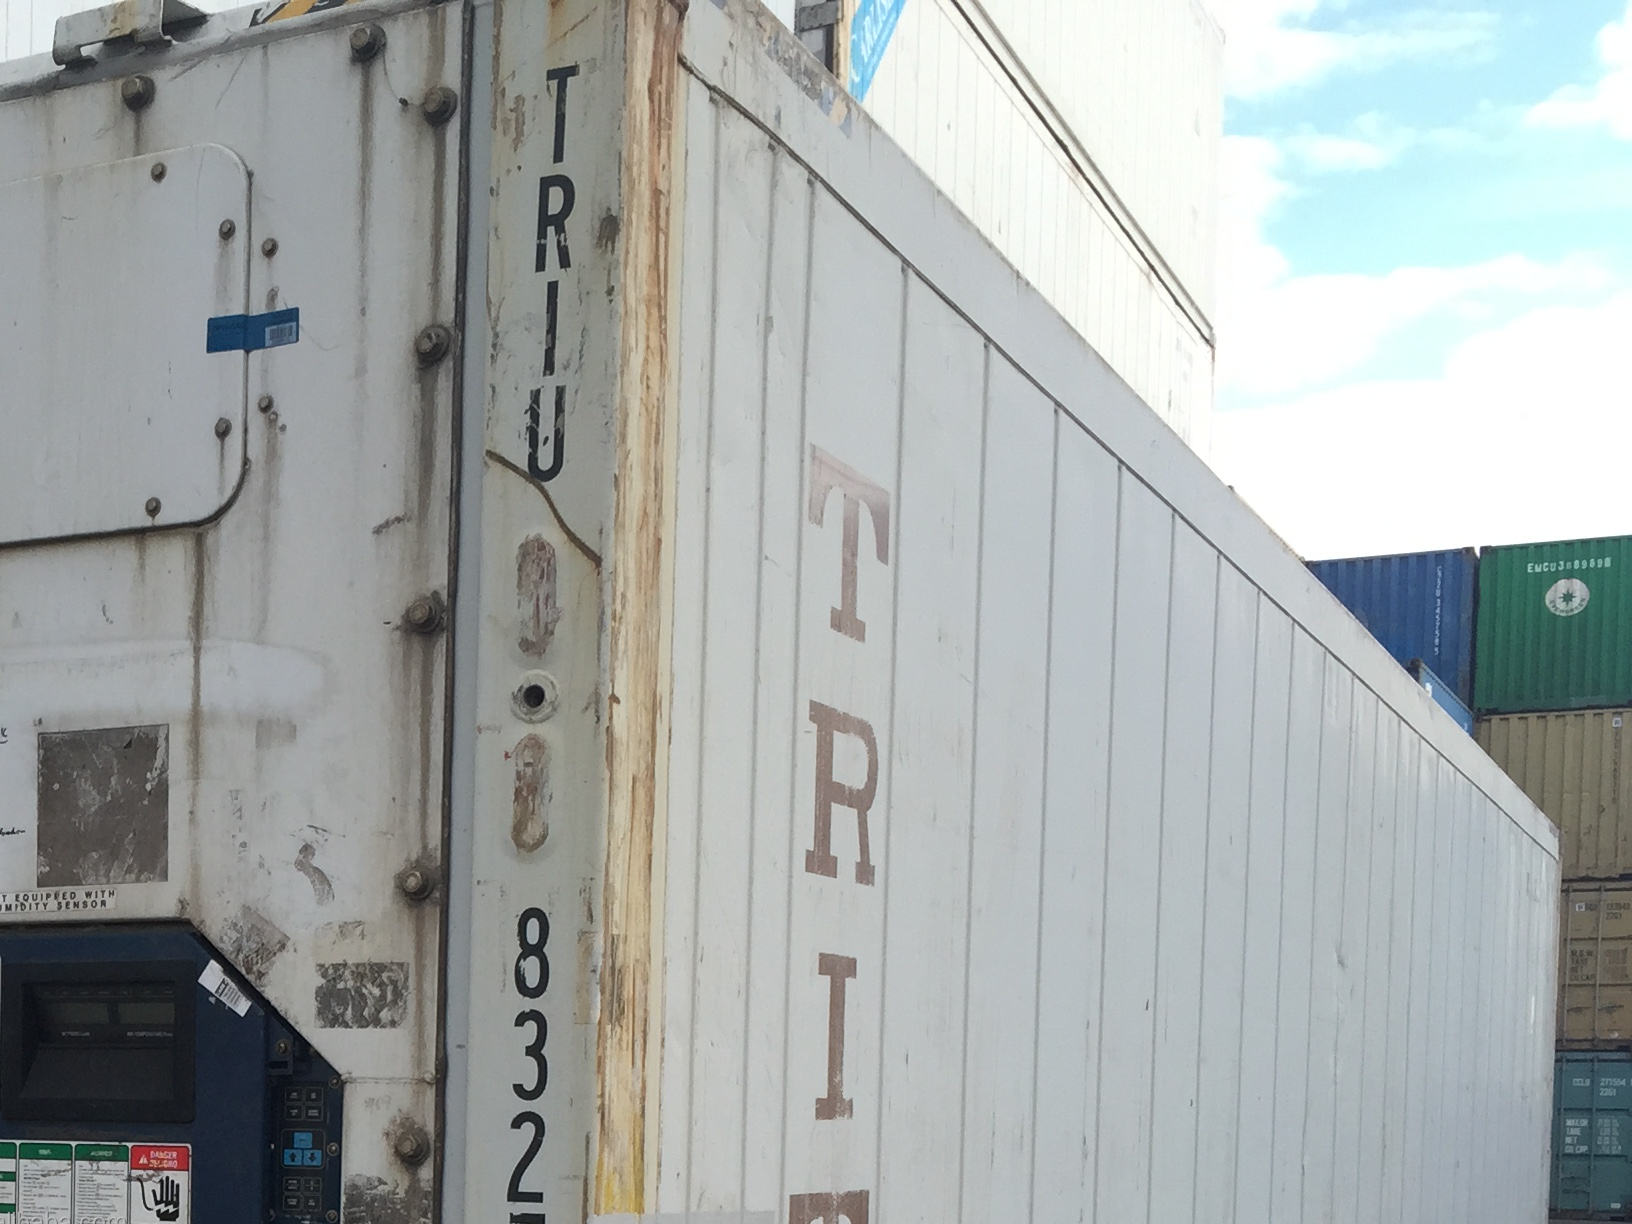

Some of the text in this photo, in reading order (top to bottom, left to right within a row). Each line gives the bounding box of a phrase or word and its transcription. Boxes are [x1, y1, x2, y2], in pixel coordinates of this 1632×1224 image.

[528, 64, 580, 483] TRIU
[14, 890, 77, 902] EQUIPPED
[84, 889, 115, 899] WITH
[56, 899, 107, 911] SENSOR
[149, 1150, 178, 1160] DANGER
